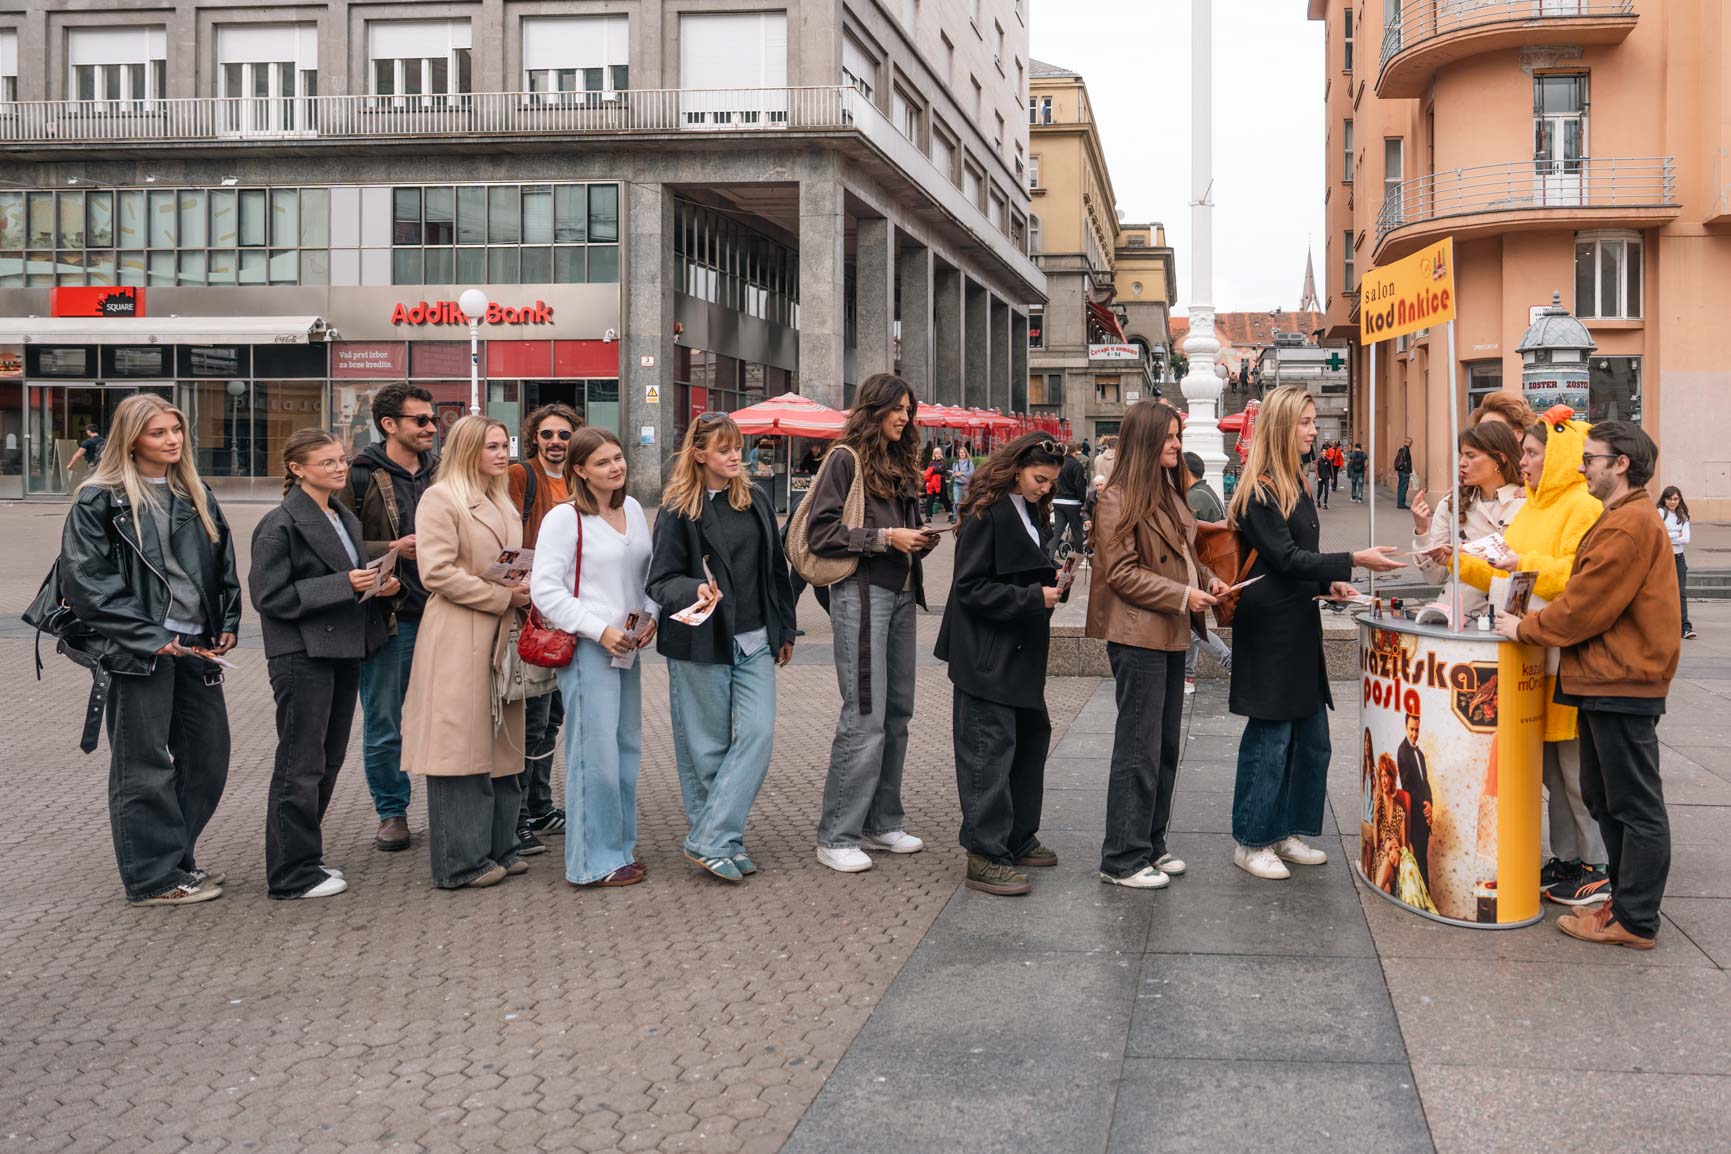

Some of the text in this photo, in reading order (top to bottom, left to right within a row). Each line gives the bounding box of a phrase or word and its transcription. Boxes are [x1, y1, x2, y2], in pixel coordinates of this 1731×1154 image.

[1365, 281, 1395, 304] salon
[106, 303, 134, 312] SQUARE
[391, 300, 553, 324] Addik Bank
[1365, 288, 1450, 335] kod Ankice
[353, 351, 369, 360] prvi
[370, 351, 388, 359] izbor
[1528, 381, 1558, 390] ZOSTER
[1363, 676, 1421, 717] posla
